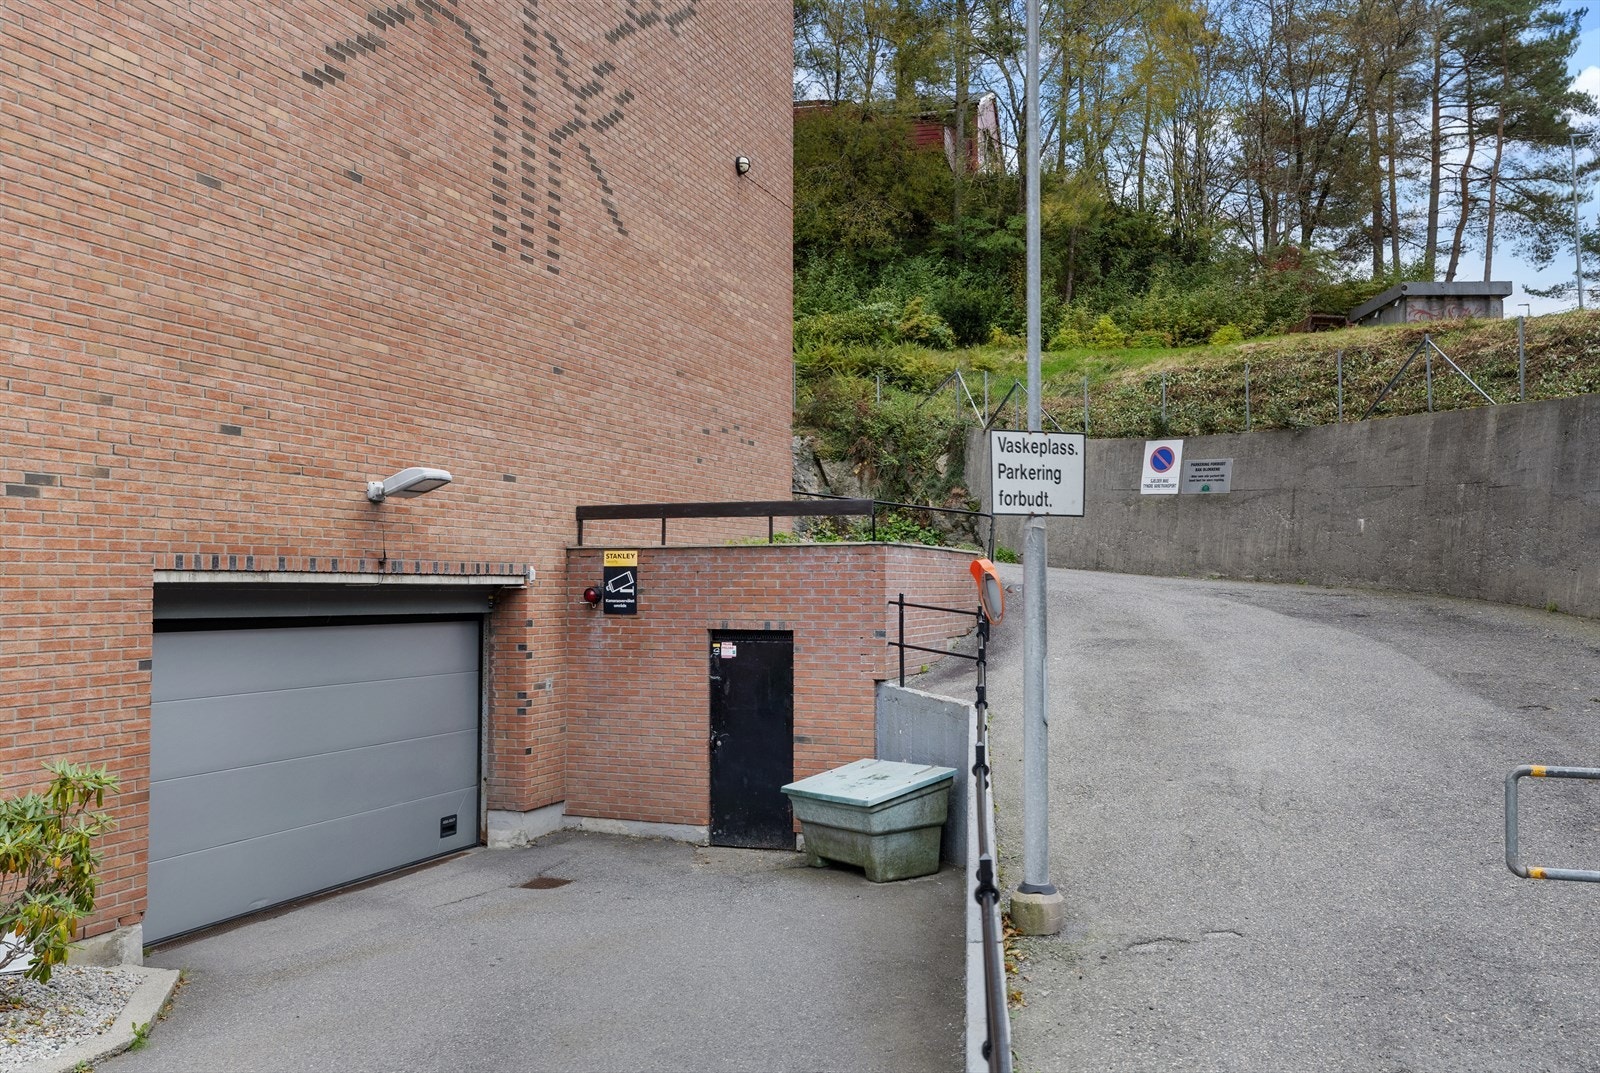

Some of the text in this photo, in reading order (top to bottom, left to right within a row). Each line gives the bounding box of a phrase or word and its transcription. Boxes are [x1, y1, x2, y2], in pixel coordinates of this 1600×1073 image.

[998, 436, 1078, 457] Vaskeplass.
[998, 463, 1062, 485] Parkering
[999, 490, 1052, 507] forbudt.
